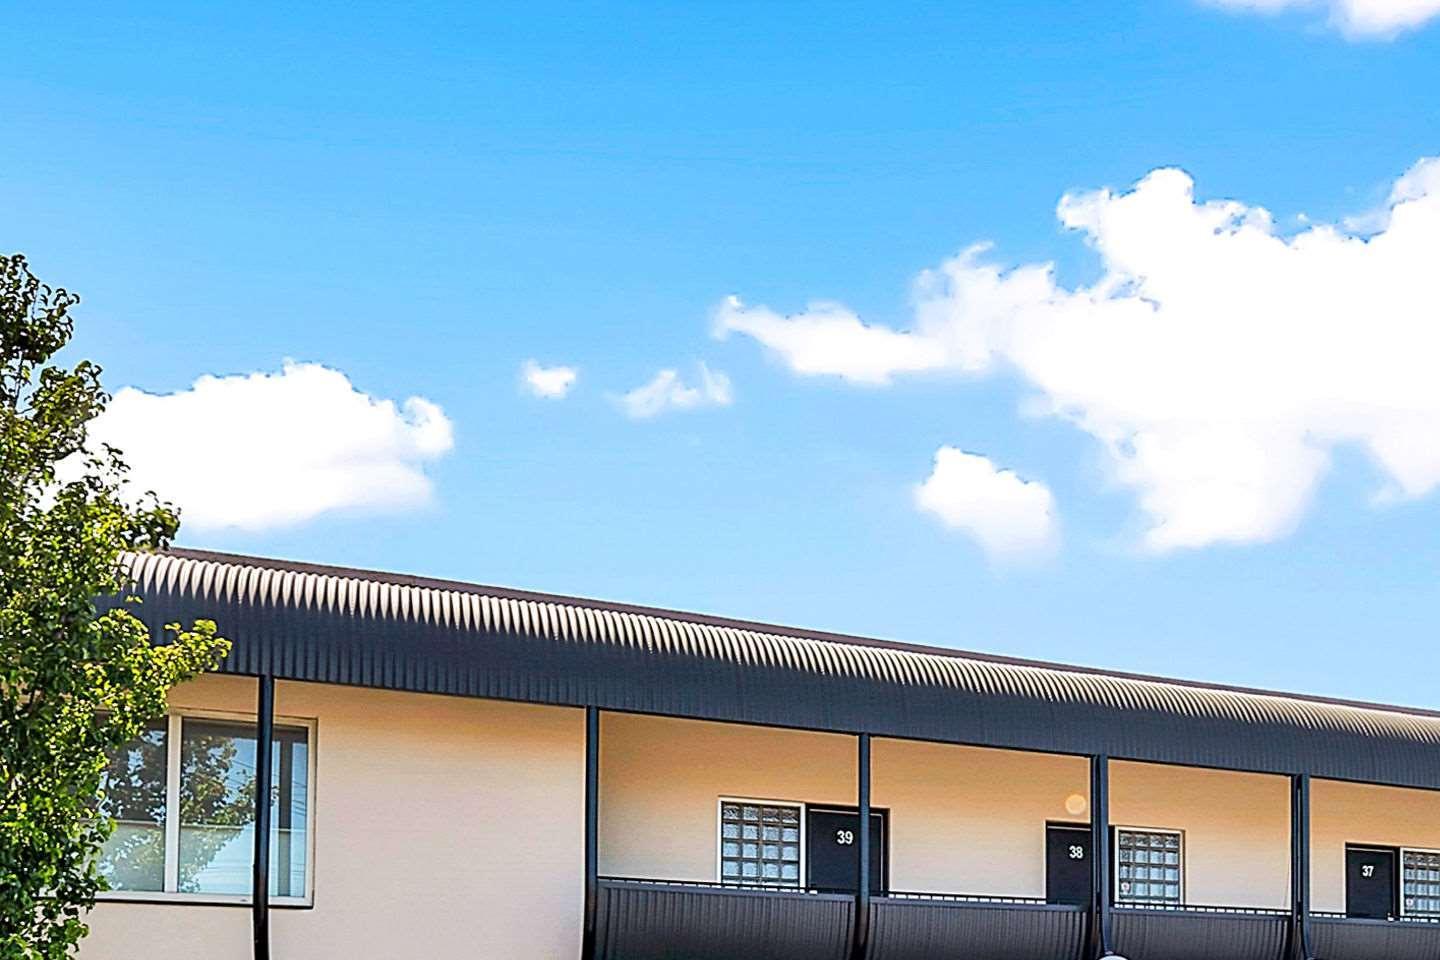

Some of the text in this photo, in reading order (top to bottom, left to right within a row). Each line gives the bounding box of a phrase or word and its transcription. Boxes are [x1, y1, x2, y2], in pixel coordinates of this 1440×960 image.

[836, 830, 854, 845] 39
[1069, 845, 1083, 859] 38
[1362, 865, 1374, 877] 37
